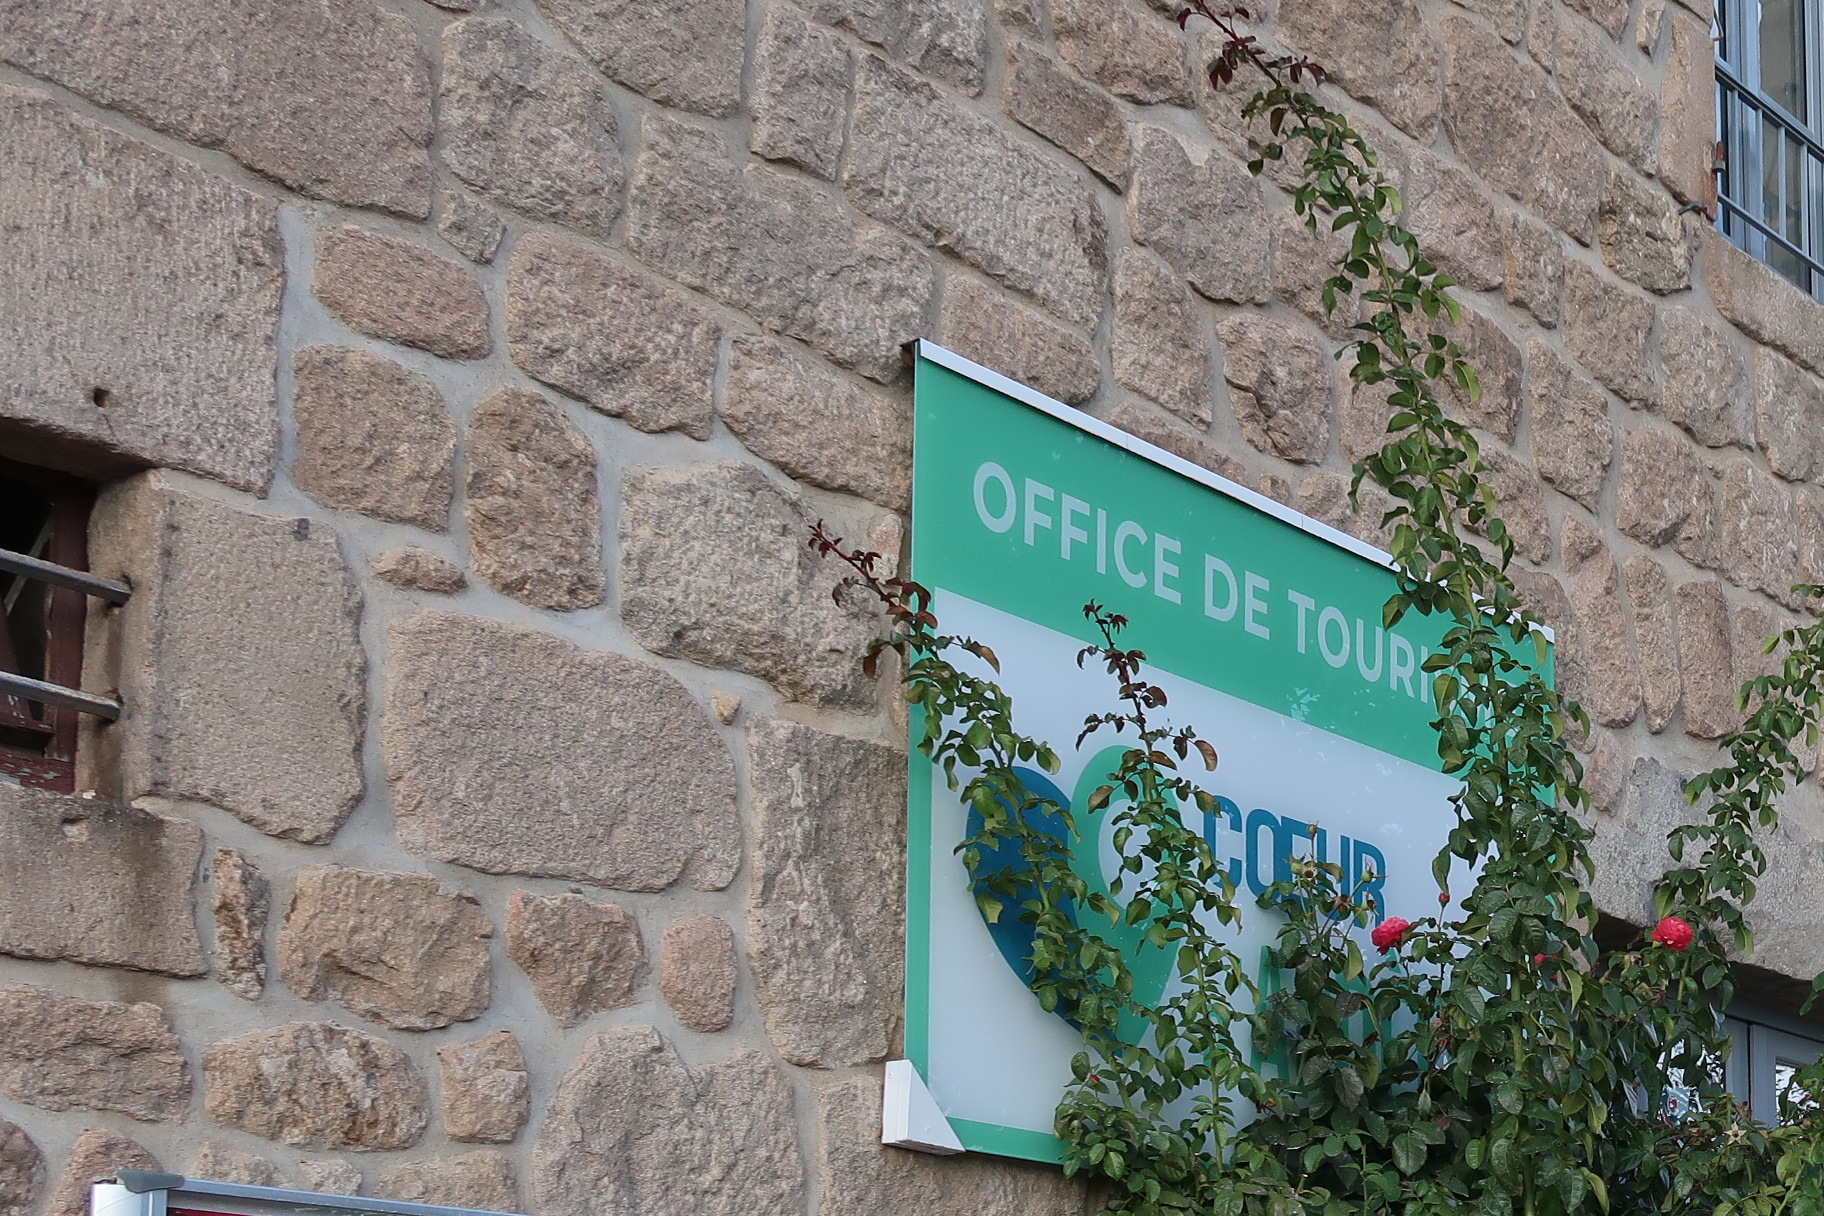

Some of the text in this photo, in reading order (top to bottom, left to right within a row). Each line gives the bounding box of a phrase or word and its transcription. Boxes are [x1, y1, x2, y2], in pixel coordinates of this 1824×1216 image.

[973, 462, 1495, 728] OFFICE DE TOURI
